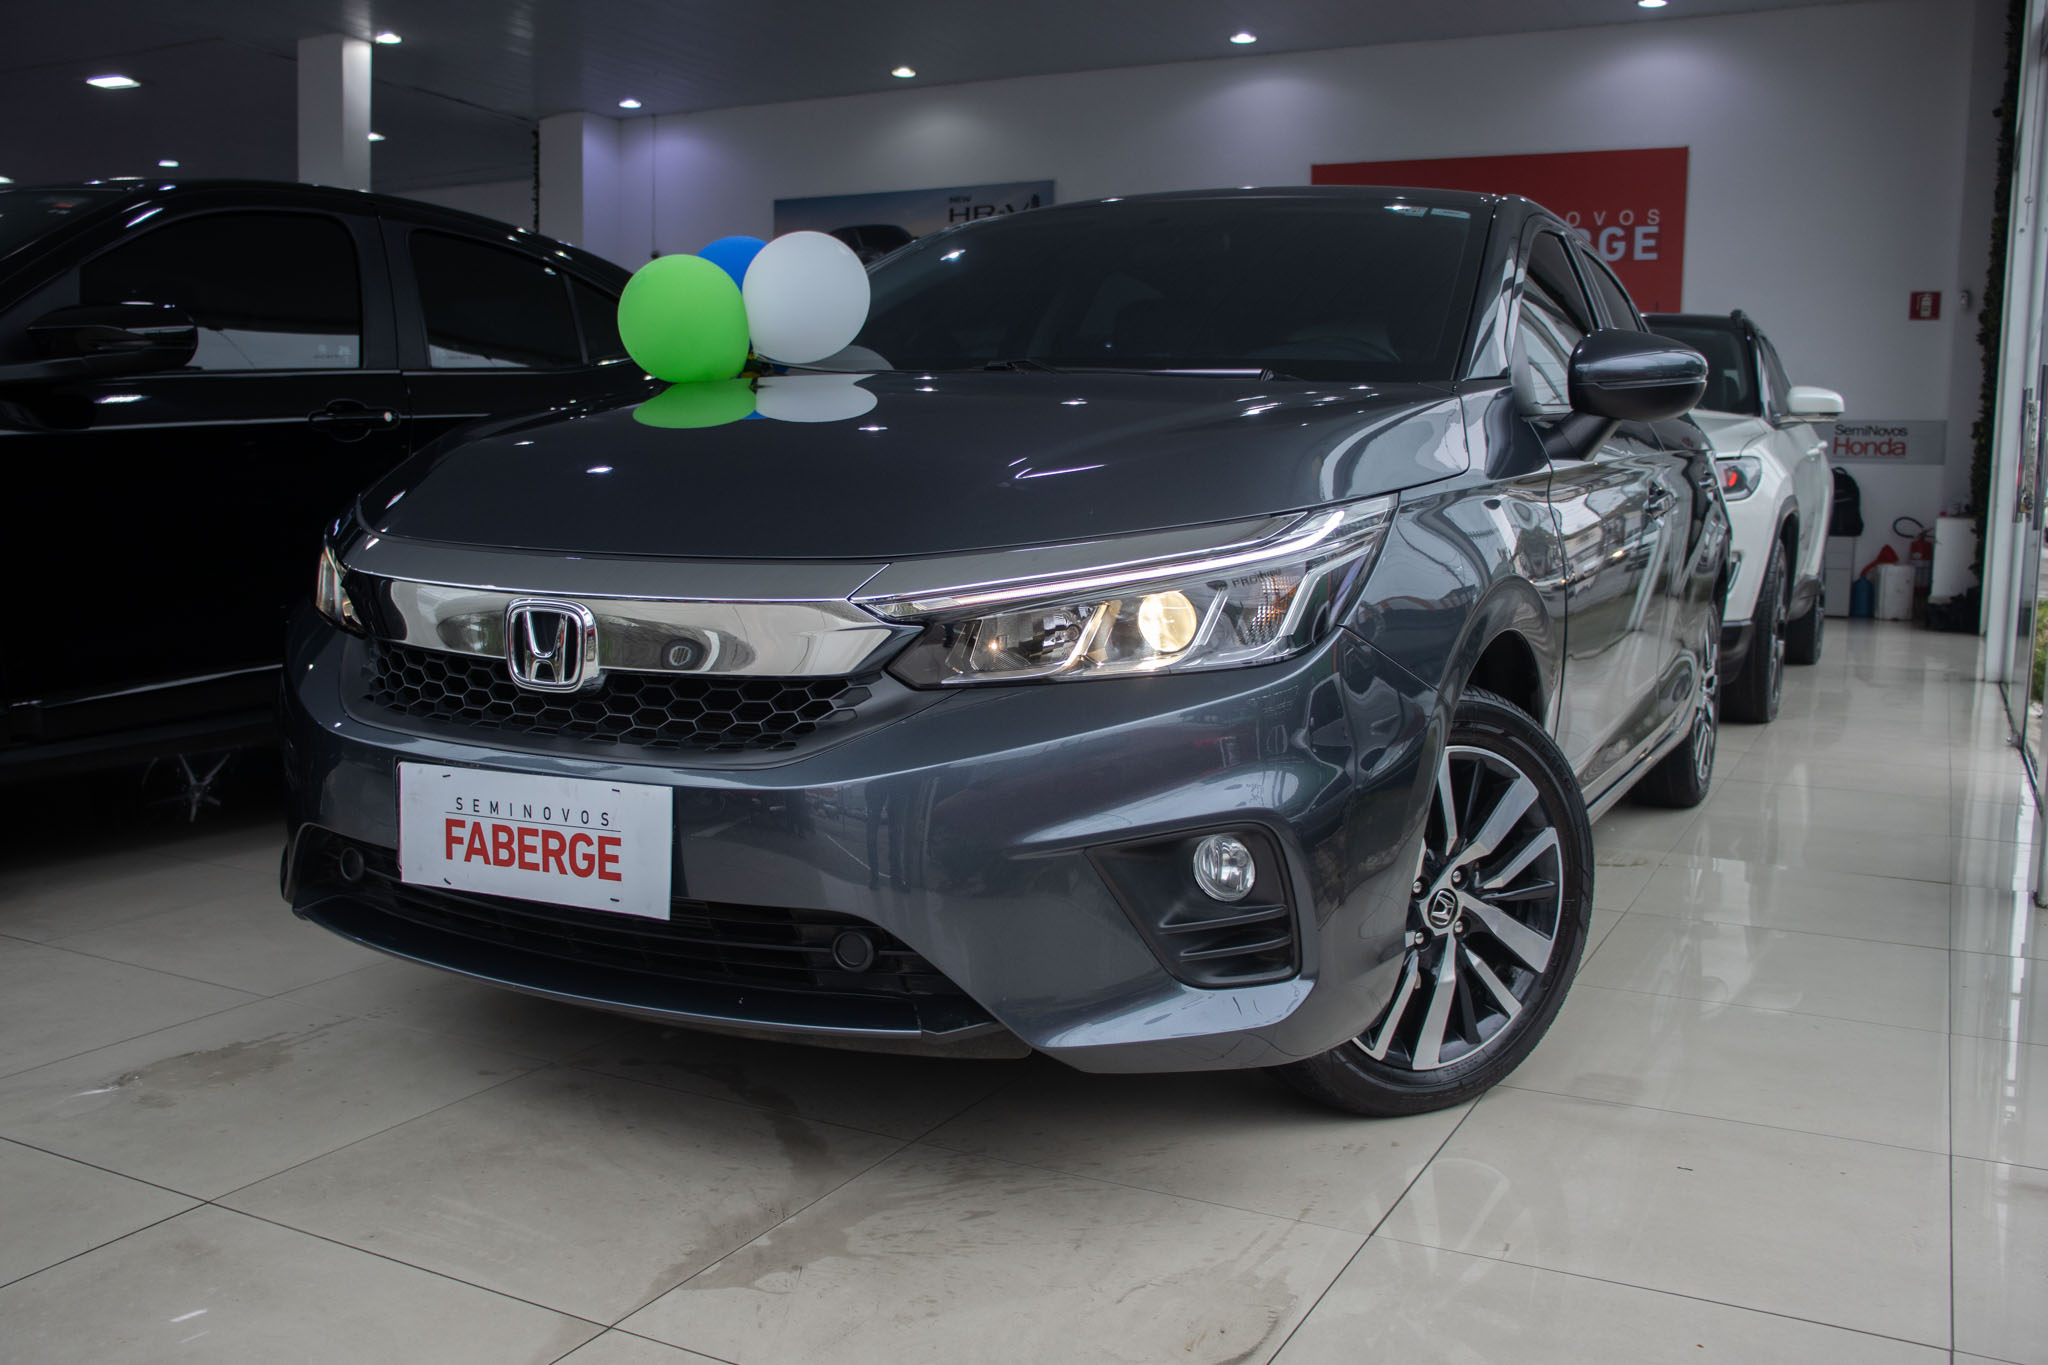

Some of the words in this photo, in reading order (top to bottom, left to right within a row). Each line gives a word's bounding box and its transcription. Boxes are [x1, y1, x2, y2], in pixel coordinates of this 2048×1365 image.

[1834, 424, 1908, 437] SemiNovos
[1833, 436, 1906, 457] Honda
[455, 796, 610, 827] SEMINOVOS
[445, 818, 622, 882] FABERGE
